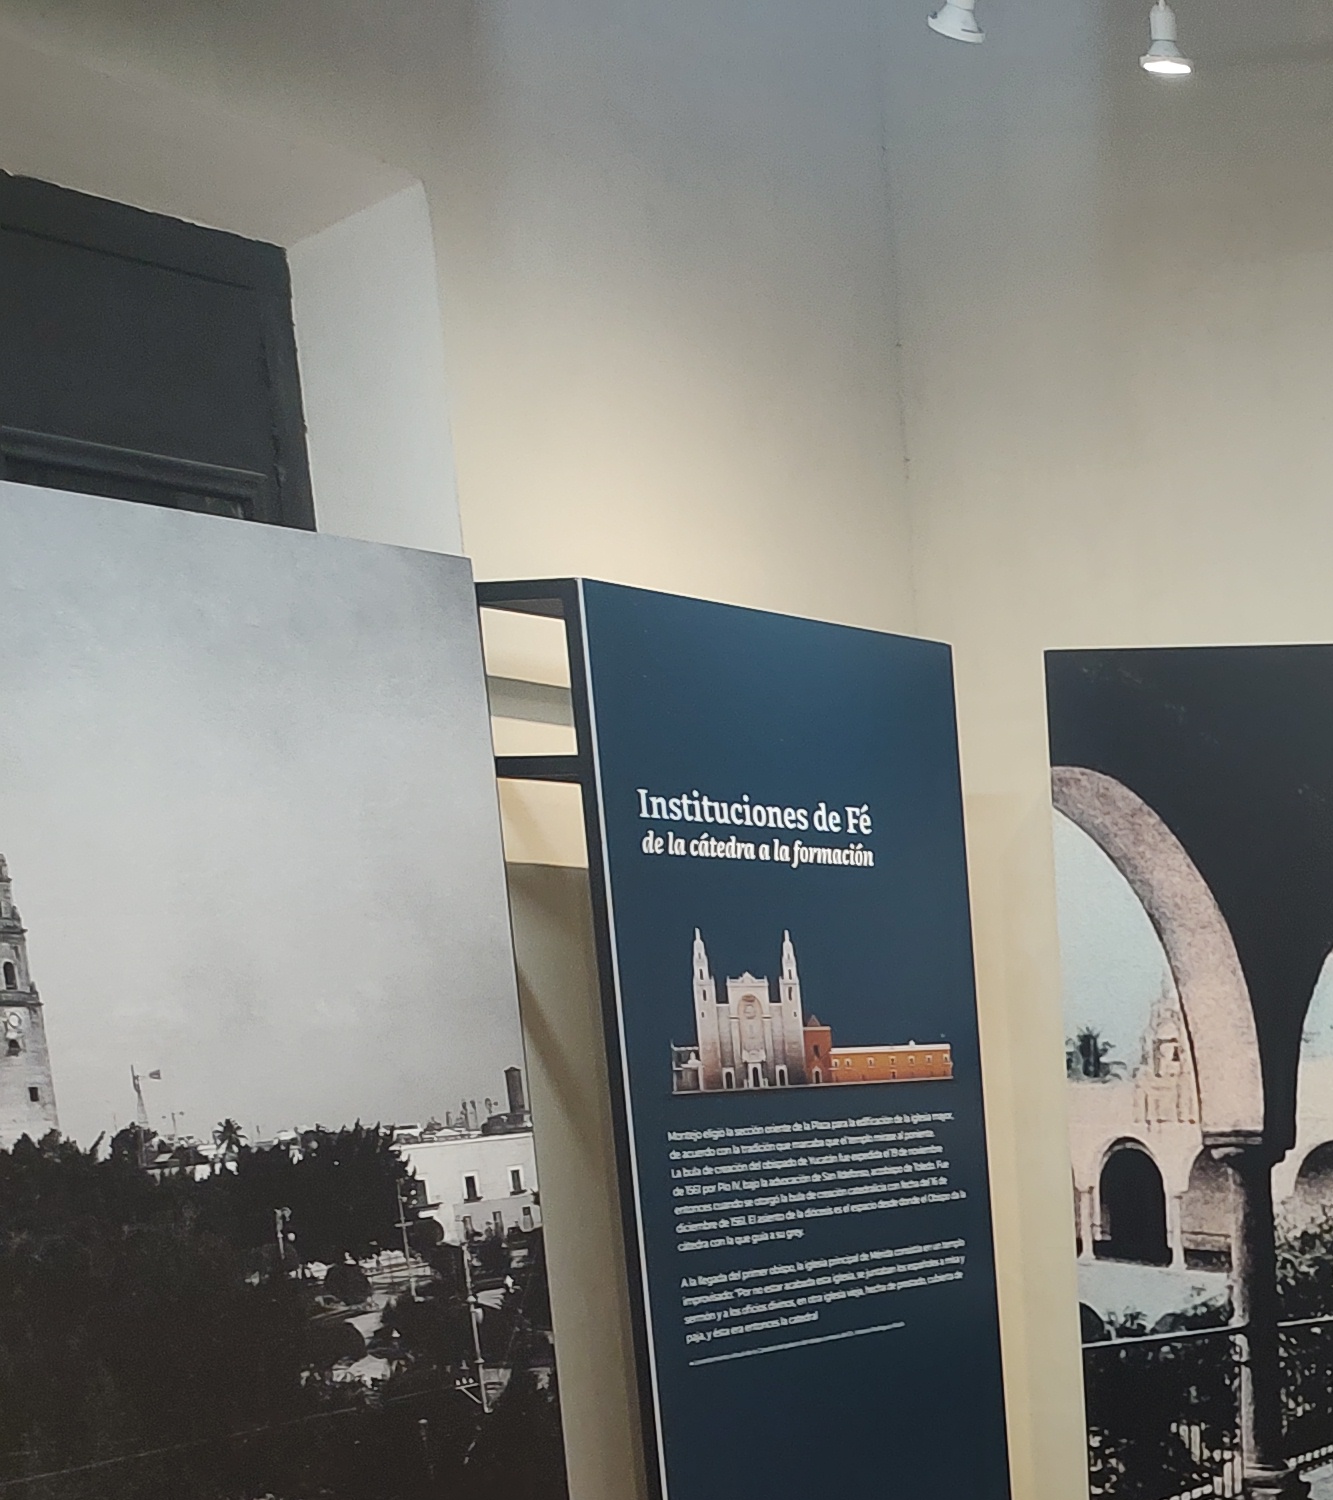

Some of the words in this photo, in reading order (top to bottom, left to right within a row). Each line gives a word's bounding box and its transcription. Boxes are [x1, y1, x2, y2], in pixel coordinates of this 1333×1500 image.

[637, 789, 809, 830] Instituciones
[813, 802, 842, 832] de
[845, 805, 872, 835] Fé
[642, 831, 664, 854] de
[667, 832, 687, 855] la
[689, 834, 756, 860] cátedra
[758, 844, 771, 860] a
[773, 839, 791, 862] la
[792, 840, 874, 869] formación
